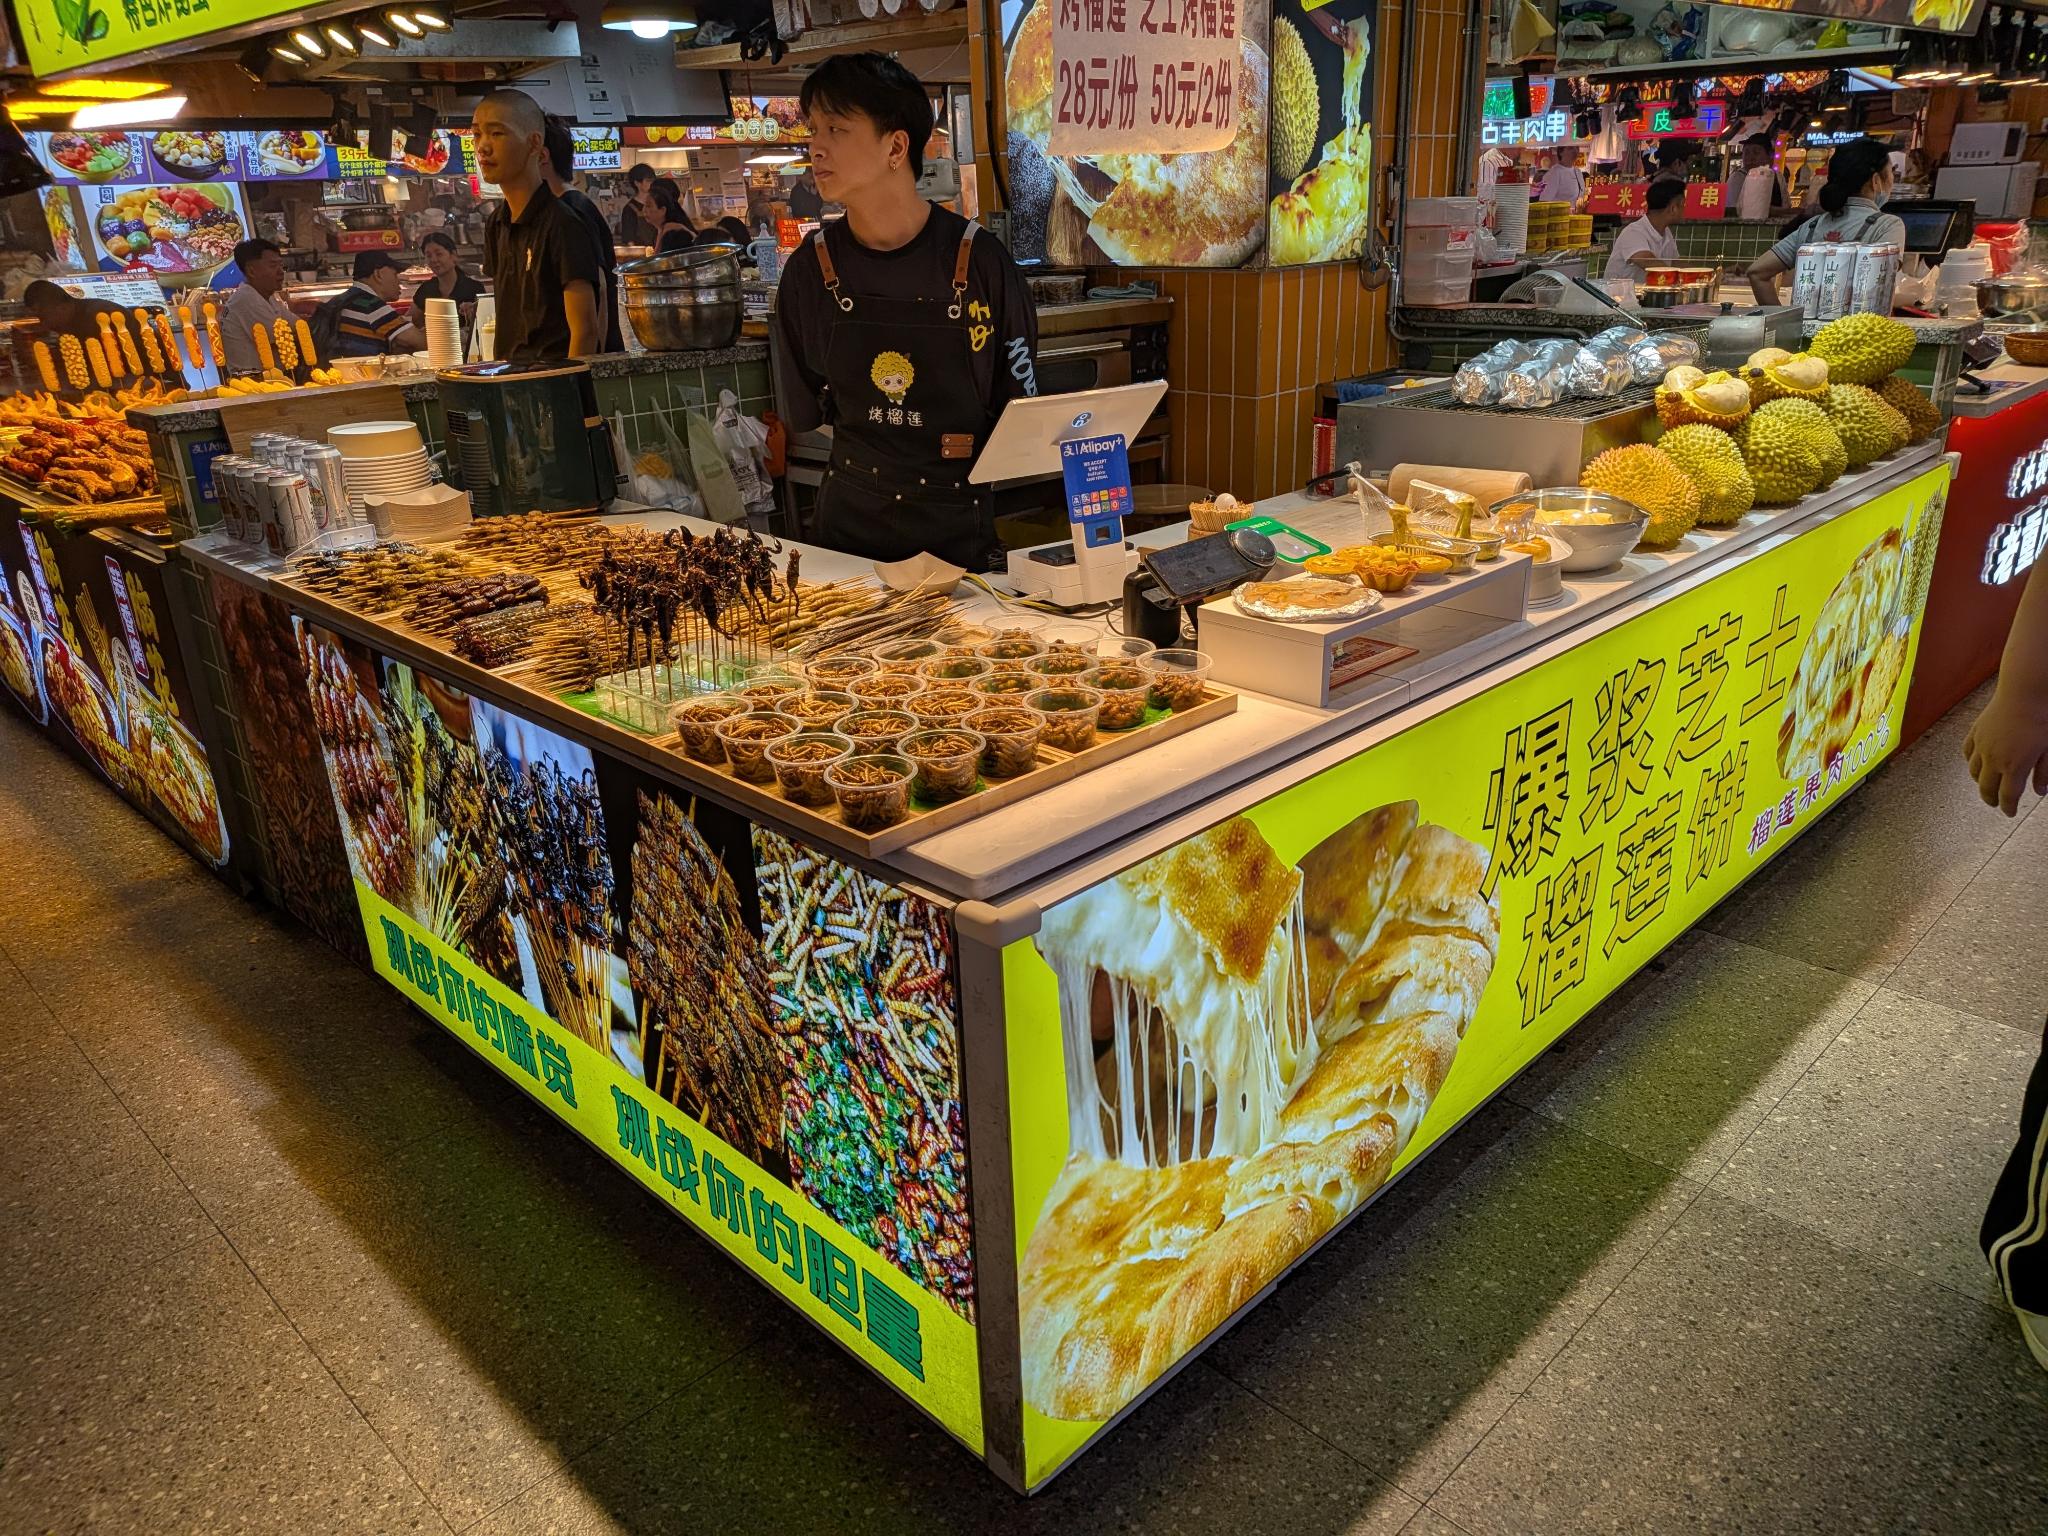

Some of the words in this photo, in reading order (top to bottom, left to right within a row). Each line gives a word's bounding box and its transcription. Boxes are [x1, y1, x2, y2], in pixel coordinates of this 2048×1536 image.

[1058, 53, 1139, 131] 28元/份
[1150, 56, 1233, 130] 50元/2份
[868, 405, 924, 427] 烤榴莲
[1478, 583, 1801, 905] 爆浆芝士
[1747, 704, 1894, 857] 榴莲果肉100%
[1515, 740, 1750, 1030] 榴莲饼
[379, 914, 578, 1110] 挑战你的味觉
[610, 1083, 926, 1384] 挑战你的胆量
